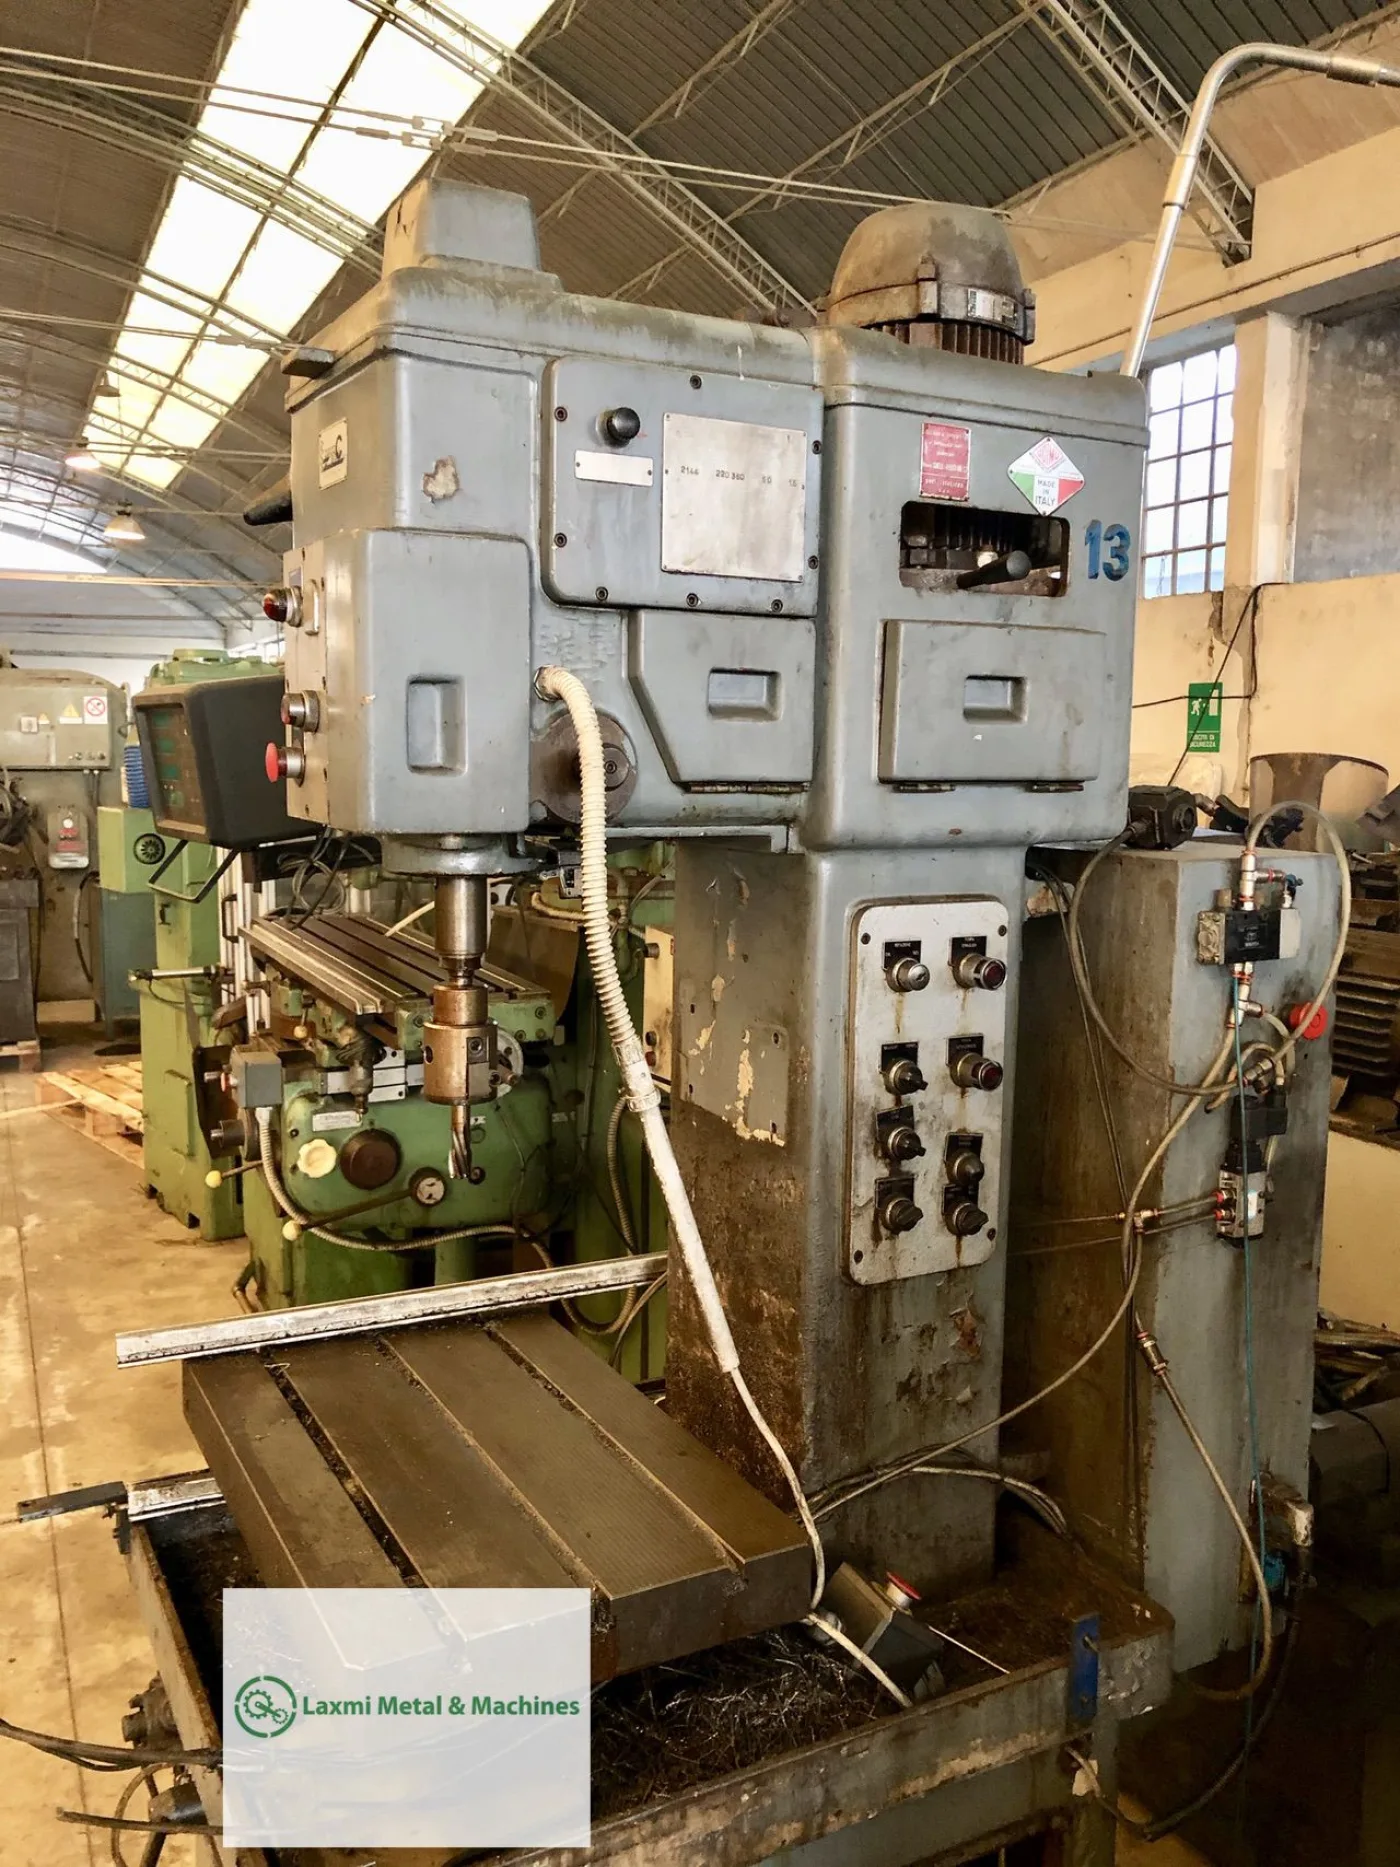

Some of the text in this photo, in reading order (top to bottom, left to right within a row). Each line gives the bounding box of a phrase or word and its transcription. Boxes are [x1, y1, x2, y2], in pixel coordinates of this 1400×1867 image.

[1038, 479, 1056, 488] MADE
[1035, 496, 1056, 507] ITALY
[1084, 519, 1131, 582] 13
